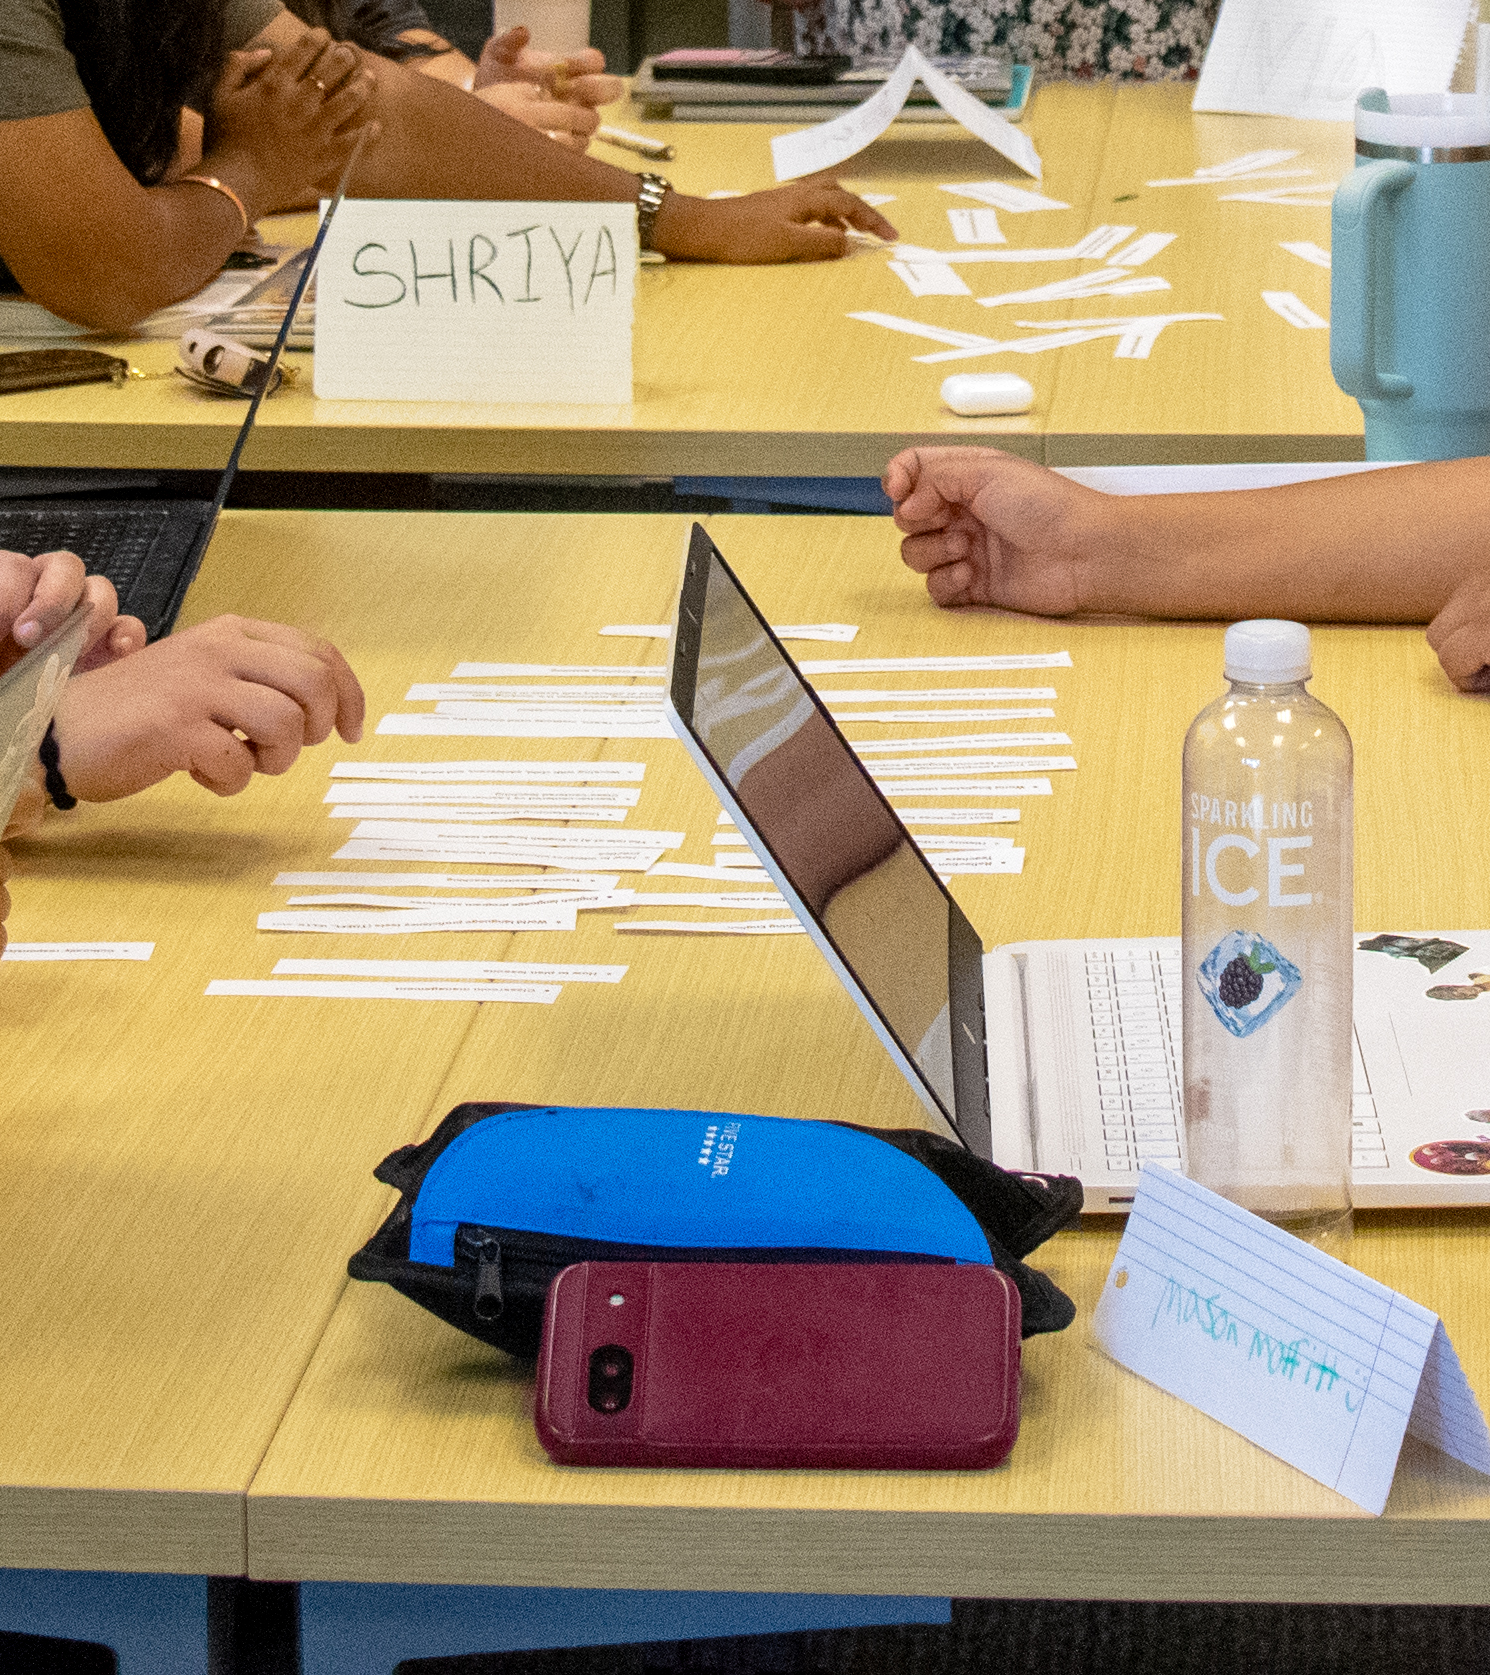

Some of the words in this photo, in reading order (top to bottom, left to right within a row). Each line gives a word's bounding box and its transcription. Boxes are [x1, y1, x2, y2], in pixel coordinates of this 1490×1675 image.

[344, 225, 617, 315] SHRIYA
[1191, 791, 1314, 830] SPARKLING
[1191, 825, 1314, 908] ICE
[719, 1121, 742, 1143] FIVE
[710, 1142, 735, 1179] STAR
